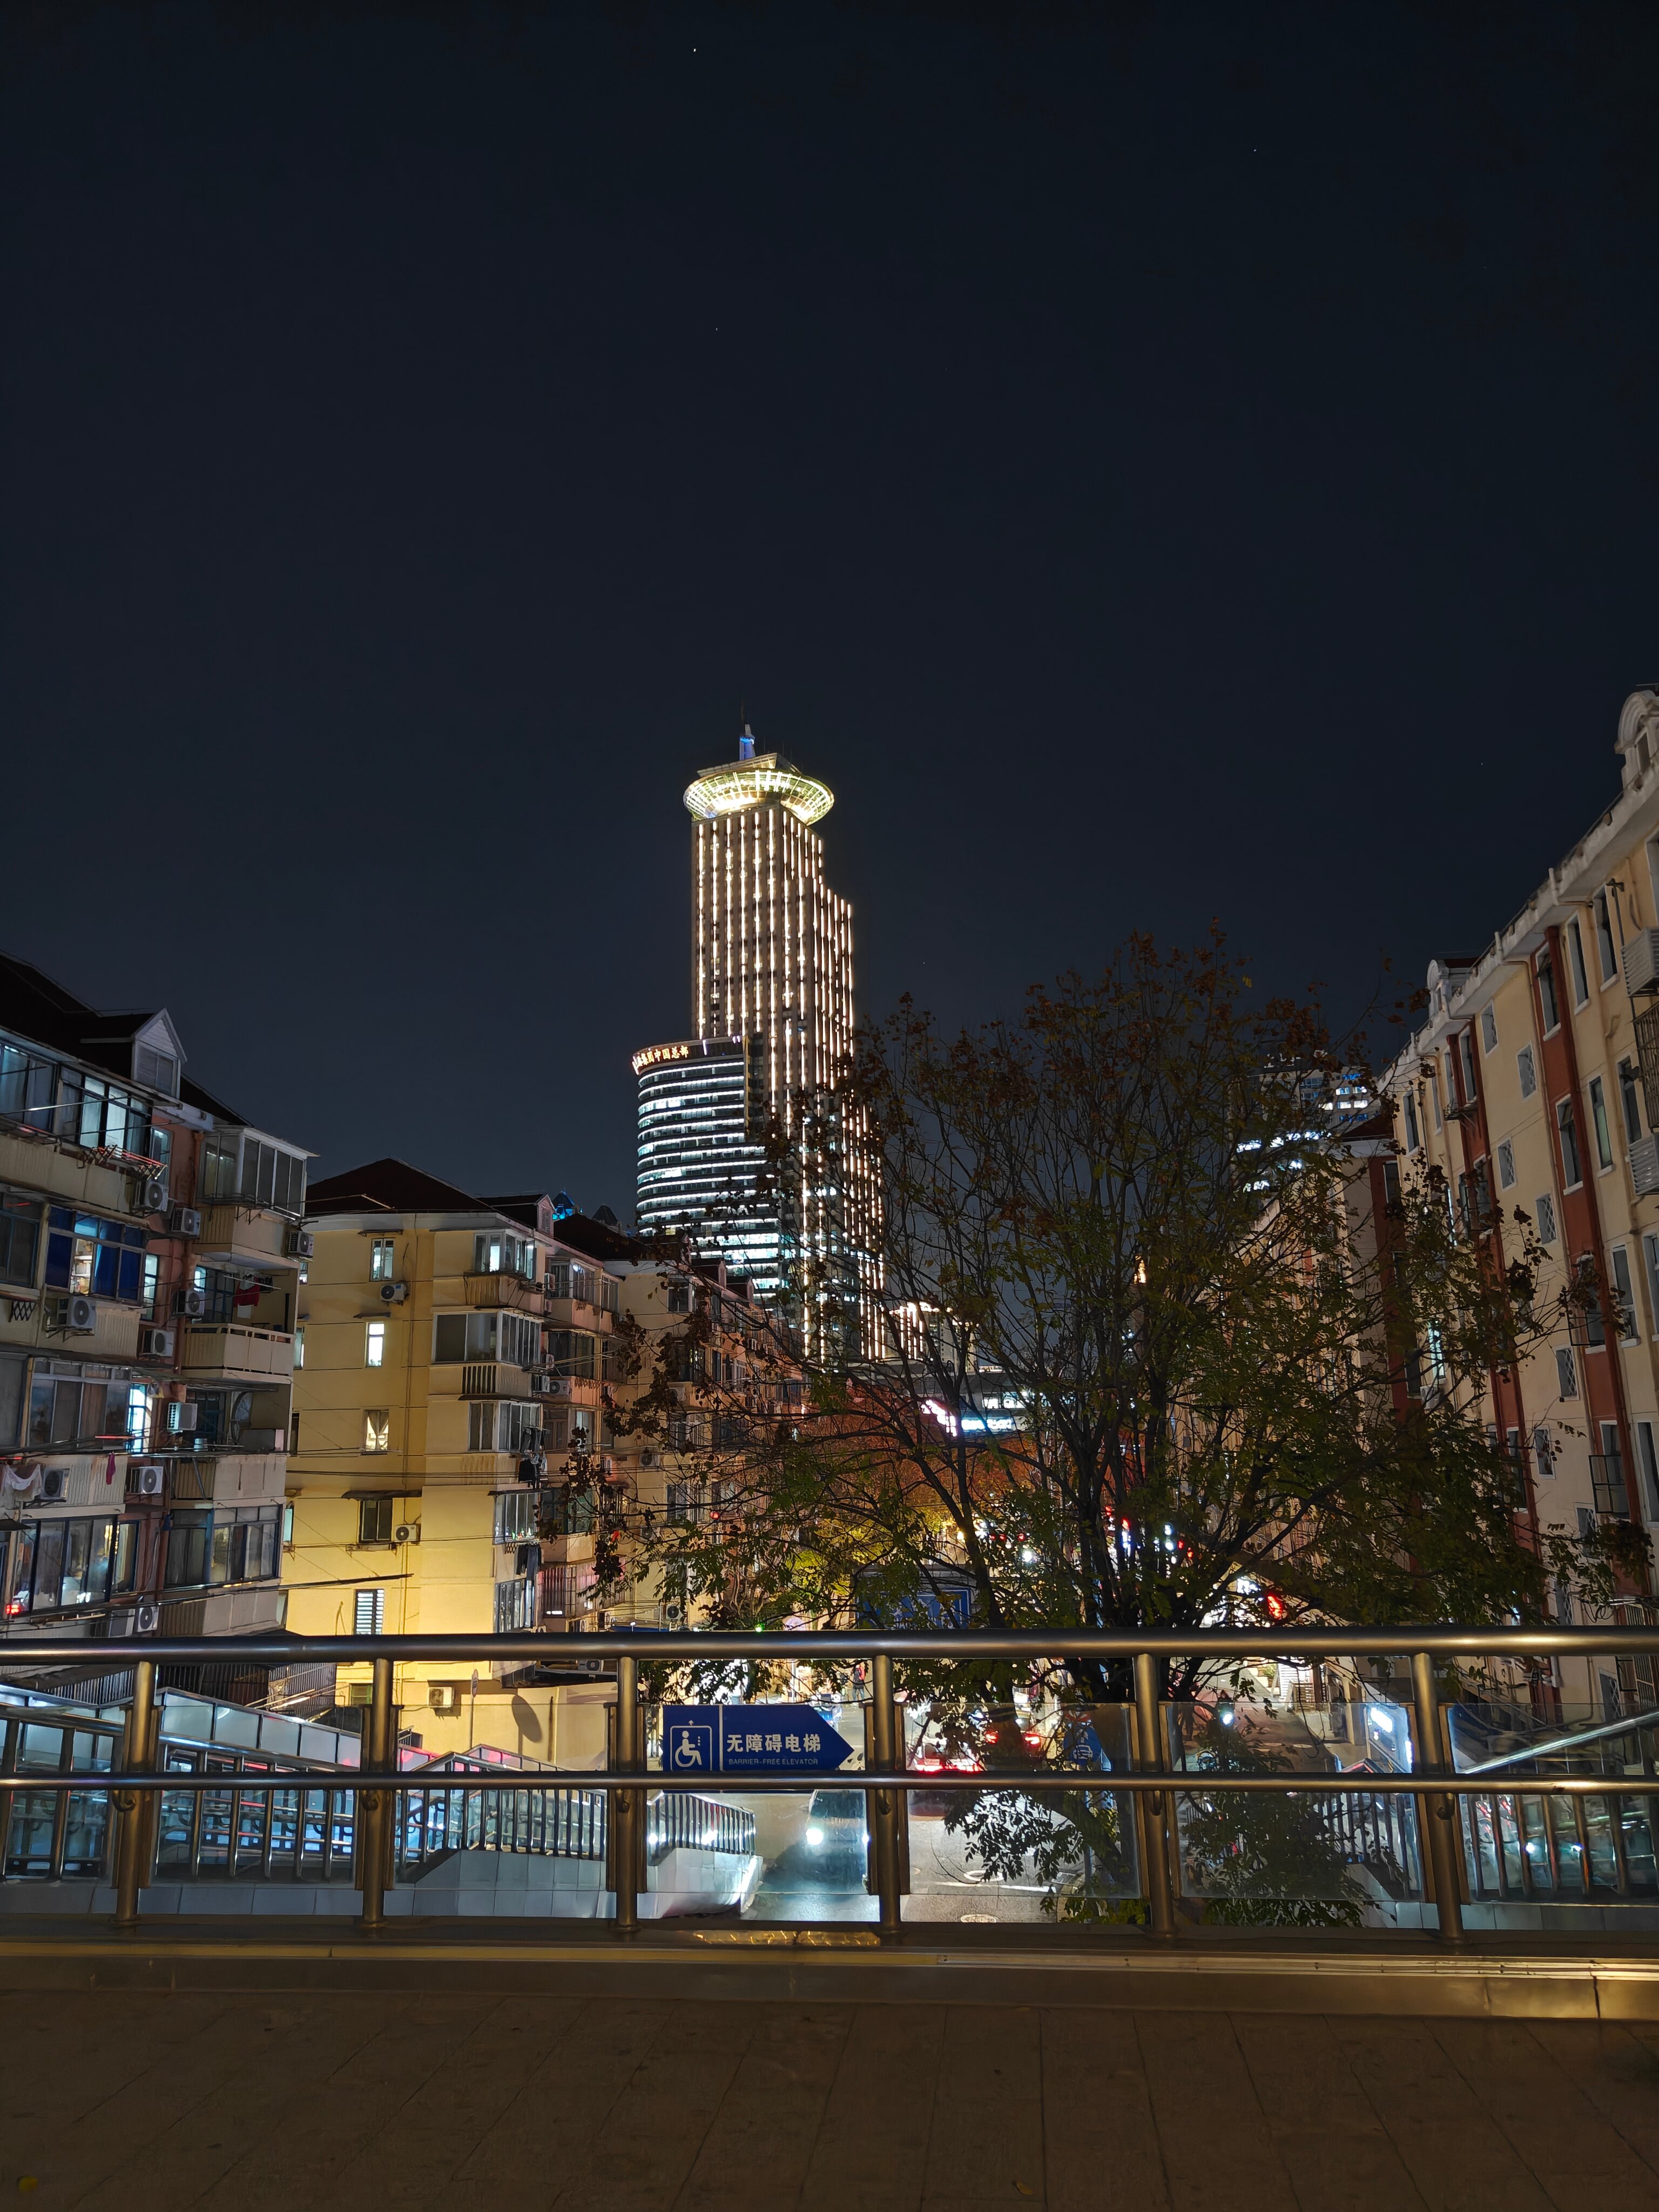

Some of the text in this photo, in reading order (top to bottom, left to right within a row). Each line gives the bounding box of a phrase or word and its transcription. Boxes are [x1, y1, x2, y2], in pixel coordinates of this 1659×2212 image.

[727, 1734, 821, 1752] 无障碍电梯
